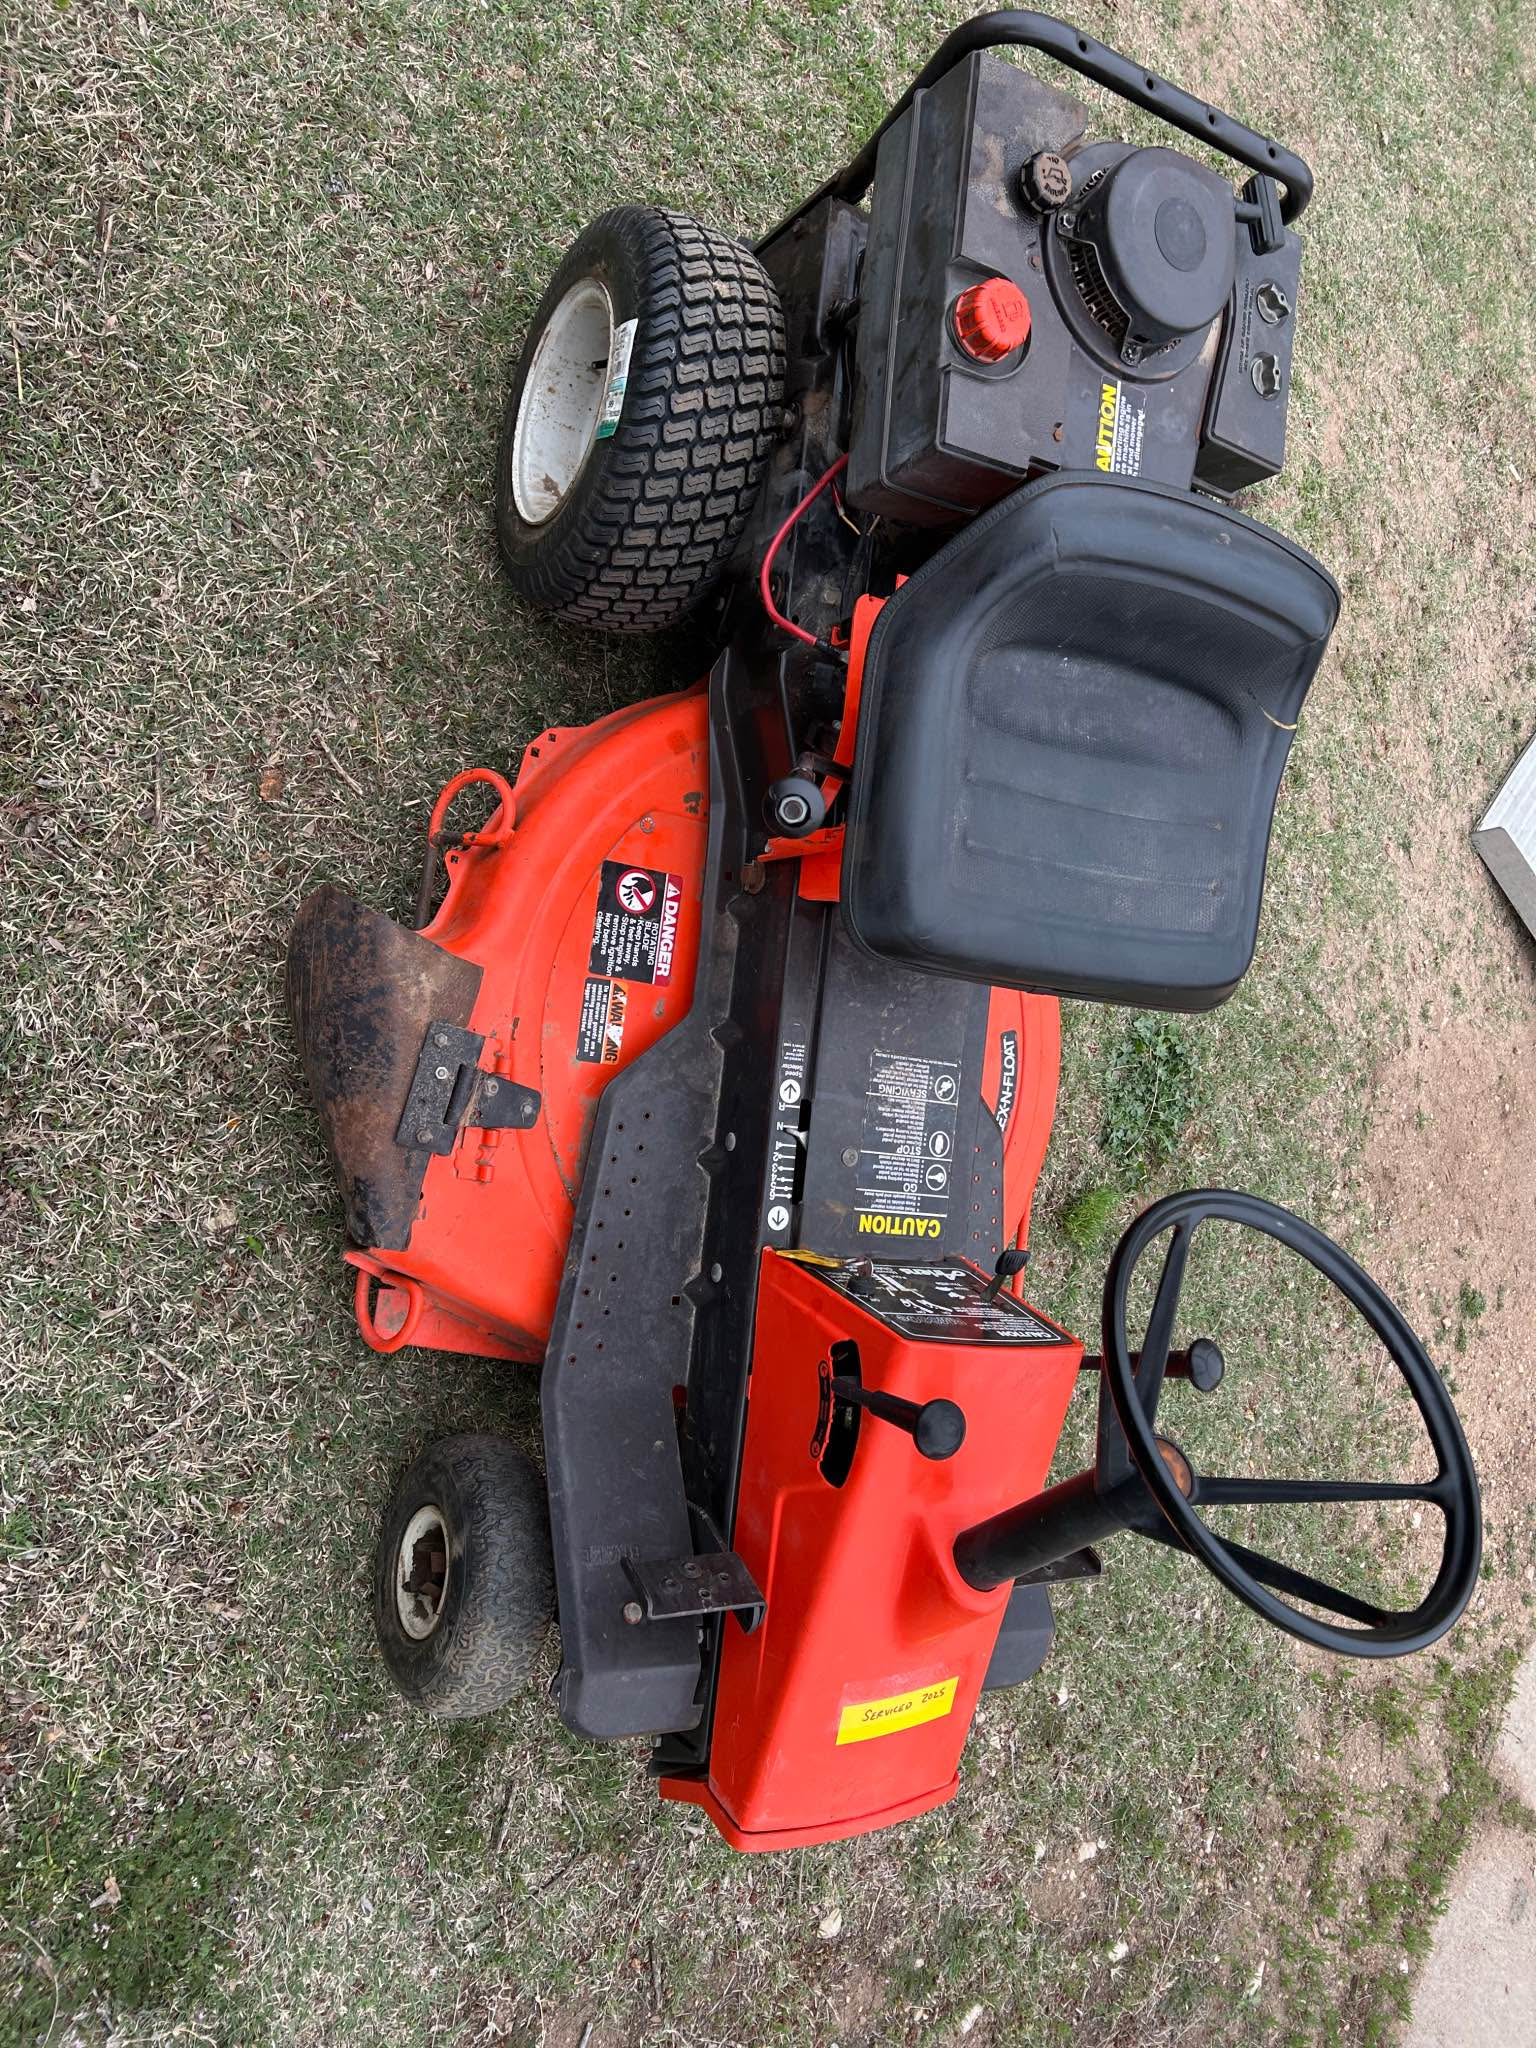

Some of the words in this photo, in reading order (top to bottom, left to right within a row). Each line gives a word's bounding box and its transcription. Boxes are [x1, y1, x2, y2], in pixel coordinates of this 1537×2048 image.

[1119, 396, 1127, 426] engine
[1125, 404, 1132, 413] in
[1125, 414, 1131, 422] is
[1096, 384, 1116, 471] AUTION
[1116, 427, 1125, 461] starting
[1122, 423, 1130, 462] machine
[1134, 462, 1139, 470] is
[592, 911, 604, 946] clearing.
[603, 913, 612, 928] key
[611, 915, 620, 945] remove
[619, 916, 629, 936] Stop
[635, 919, 644, 940] Keep
[600, 929, 610, 955] before
[627, 926, 635, 942] feet
[642, 921, 651, 951] BLADE
[647, 922, 659, 965] ROTATING
[657, 900, 679, 976] DANGER
[606, 946, 618, 976] ignition
[615, 937, 626, 965] engine
[623, 942, 633, 965] away.
[632, 942, 641, 967] hands
[878, 1084, 927, 1098] SERVICING
[995, 1037, 1015, 1131] EX-N-FLOAT
[776, 1121, 784, 1131] N
[773, 1152, 779, 1161] 2
[896, 1145, 921, 1155] STOP
[903, 1183, 917, 1192] GO
[859, 1214, 941, 1238] CAUTION
[862, 1701, 913, 1722] SERVICED
[922, 1687, 946, 1703] 2025
